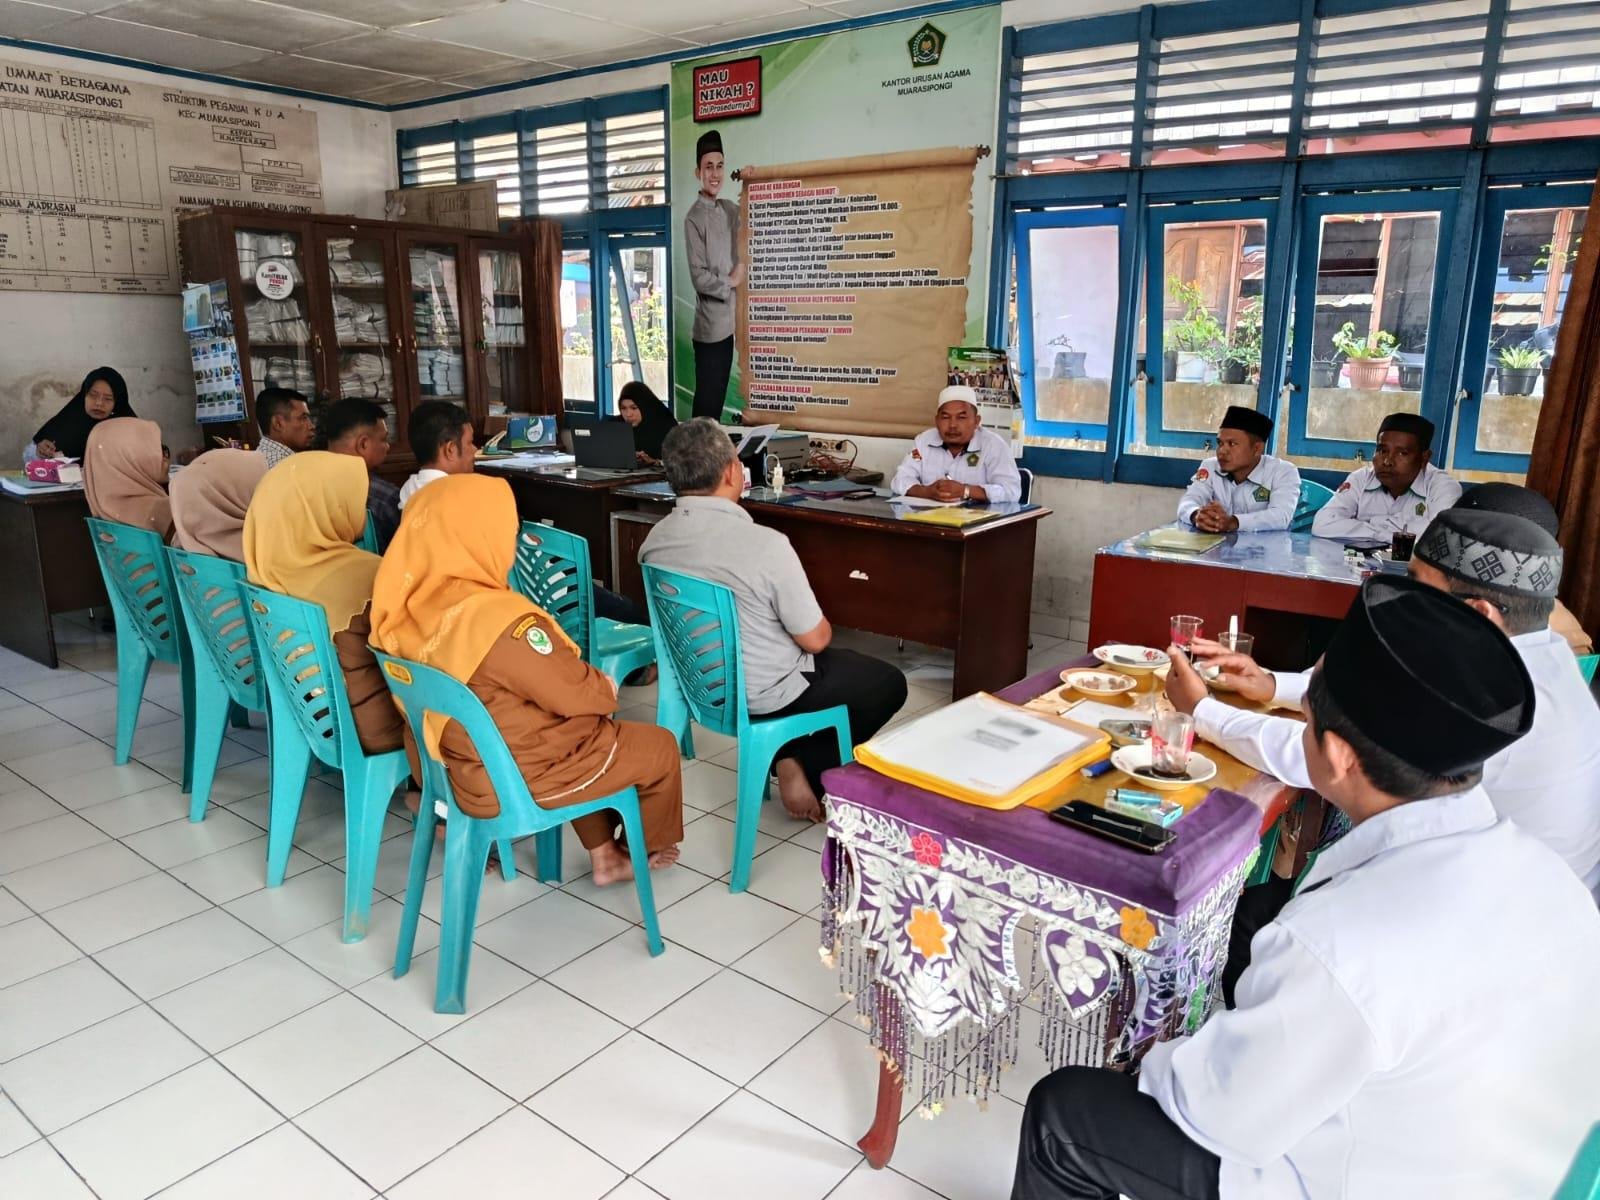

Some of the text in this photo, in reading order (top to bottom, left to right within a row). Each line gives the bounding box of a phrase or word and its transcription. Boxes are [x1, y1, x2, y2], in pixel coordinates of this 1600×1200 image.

[6, 66, 131, 96] UMMAT BERAGAMA
[700, 70, 728, 86] MAU
[881, 68, 971, 88] KANTOR URUSAN AGAMA
[700, 84, 743, 102] NIKAH
[897, 82, 953, 96] MUARASIPONGI
[35, 86, 123, 109] MUARASIPONGI
[163, 93, 208, 108] STRUKTUR
[198, 112, 261, 128] MUARASIPONGI
[27, 201, 76, 213] MADRASAH
